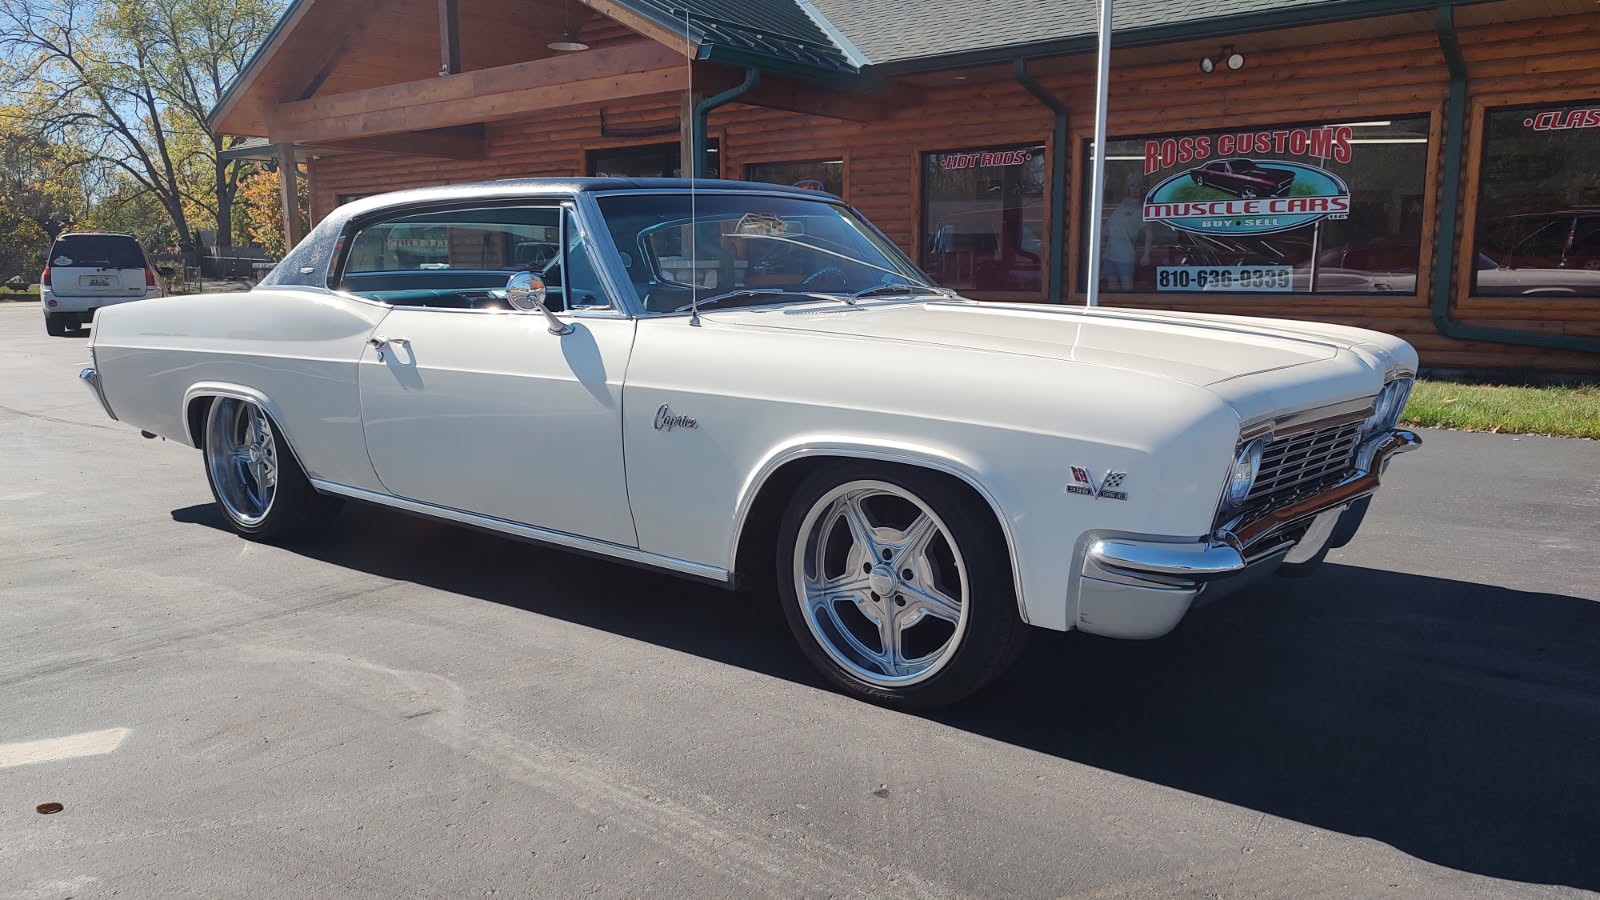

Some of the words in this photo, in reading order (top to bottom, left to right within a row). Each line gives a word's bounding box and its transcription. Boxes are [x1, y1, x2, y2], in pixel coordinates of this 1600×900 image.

[946, 154, 979, 169] HOT
[980, 150, 1026, 167] RODS
[1144, 137, 1211, 175] ROSS
[1218, 127, 1353, 164] CUSTOMS
[1144, 201, 1260, 217] MUSCLE
[1269, 197, 1349, 213] CARS
[1245, 218, 1280, 226] SELL
[1159, 270, 1290, 289] 810-636-9339
